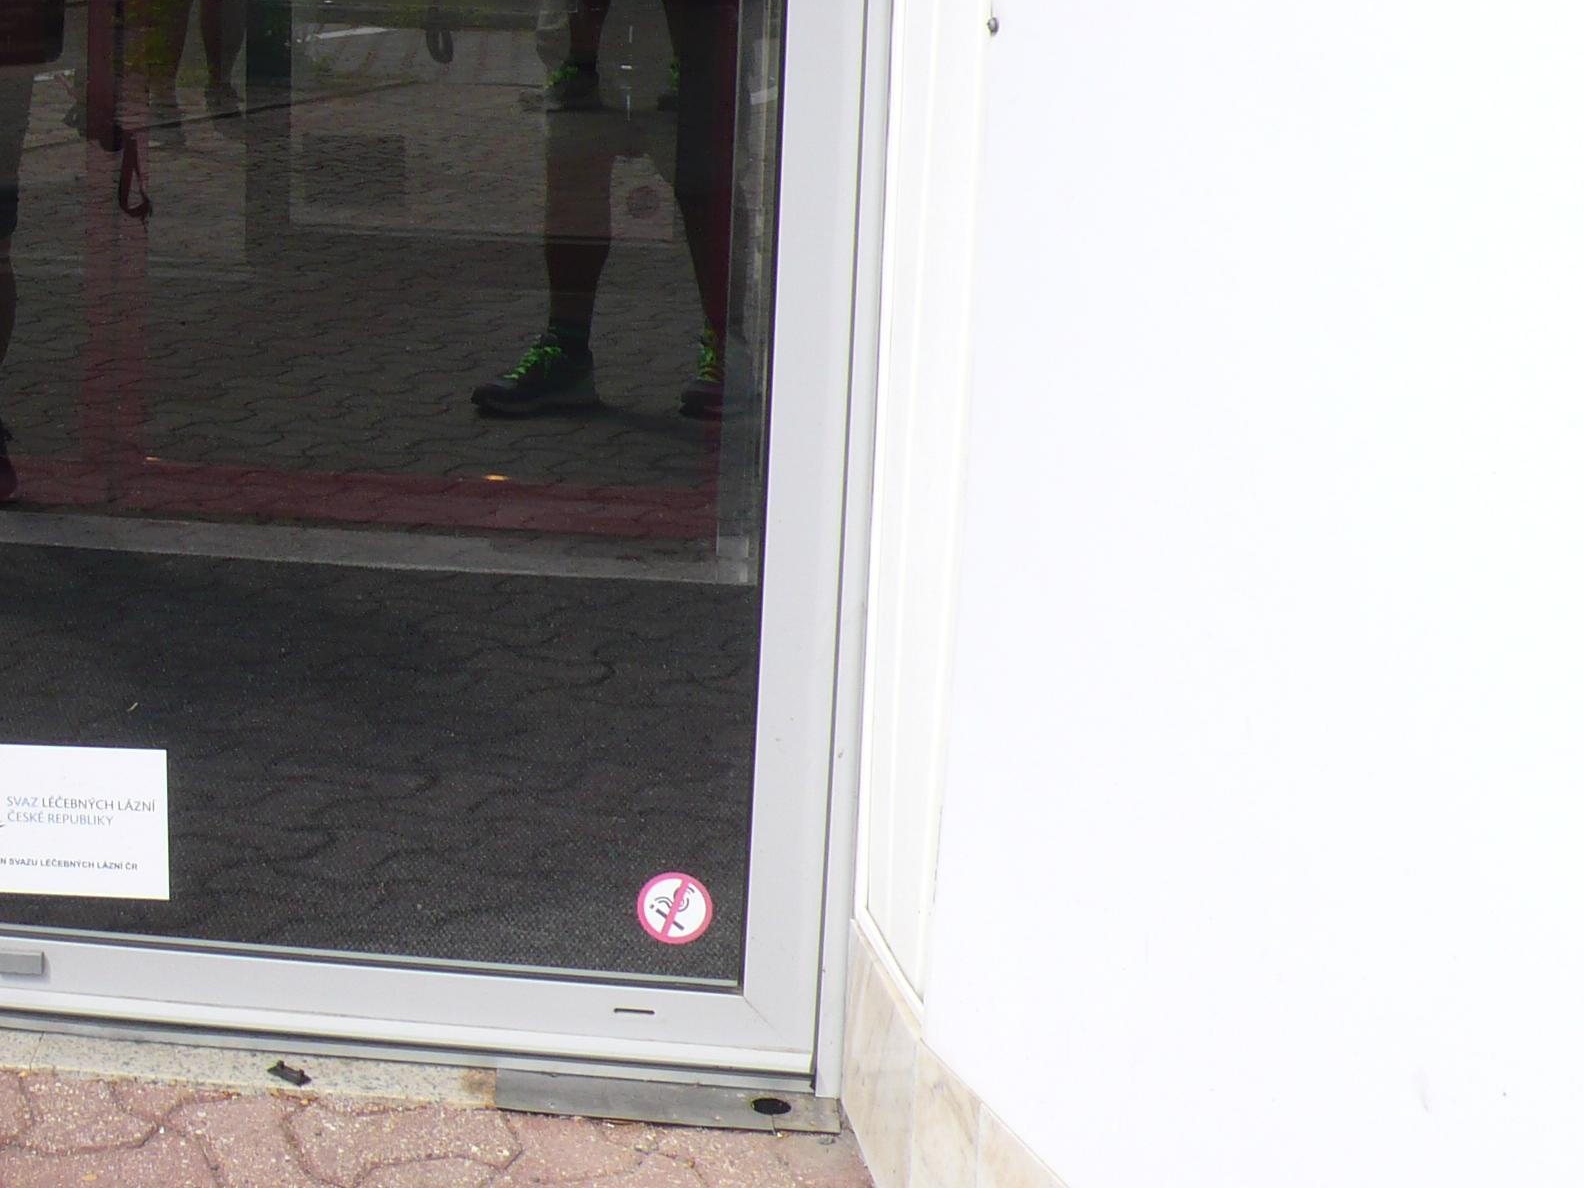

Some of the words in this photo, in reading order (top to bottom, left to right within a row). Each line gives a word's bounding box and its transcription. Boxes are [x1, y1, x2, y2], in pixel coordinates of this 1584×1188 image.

[7, 796, 38, 807] SVAZ
[42, 795, 114, 811] LÉČEBNÝCH
[118, 798, 155, 813] LÁZNÍ
[7, 811, 43, 823] ČESKÉ
[48, 813, 114, 826] REPUBLIKY
[9, 857, 38, 867] SVAZU
[40, 858, 94, 869] LÉČEBNÝCH
[97, 860, 123, 870] LÁZNÍ
[125, 859, 138, 870] ČR
